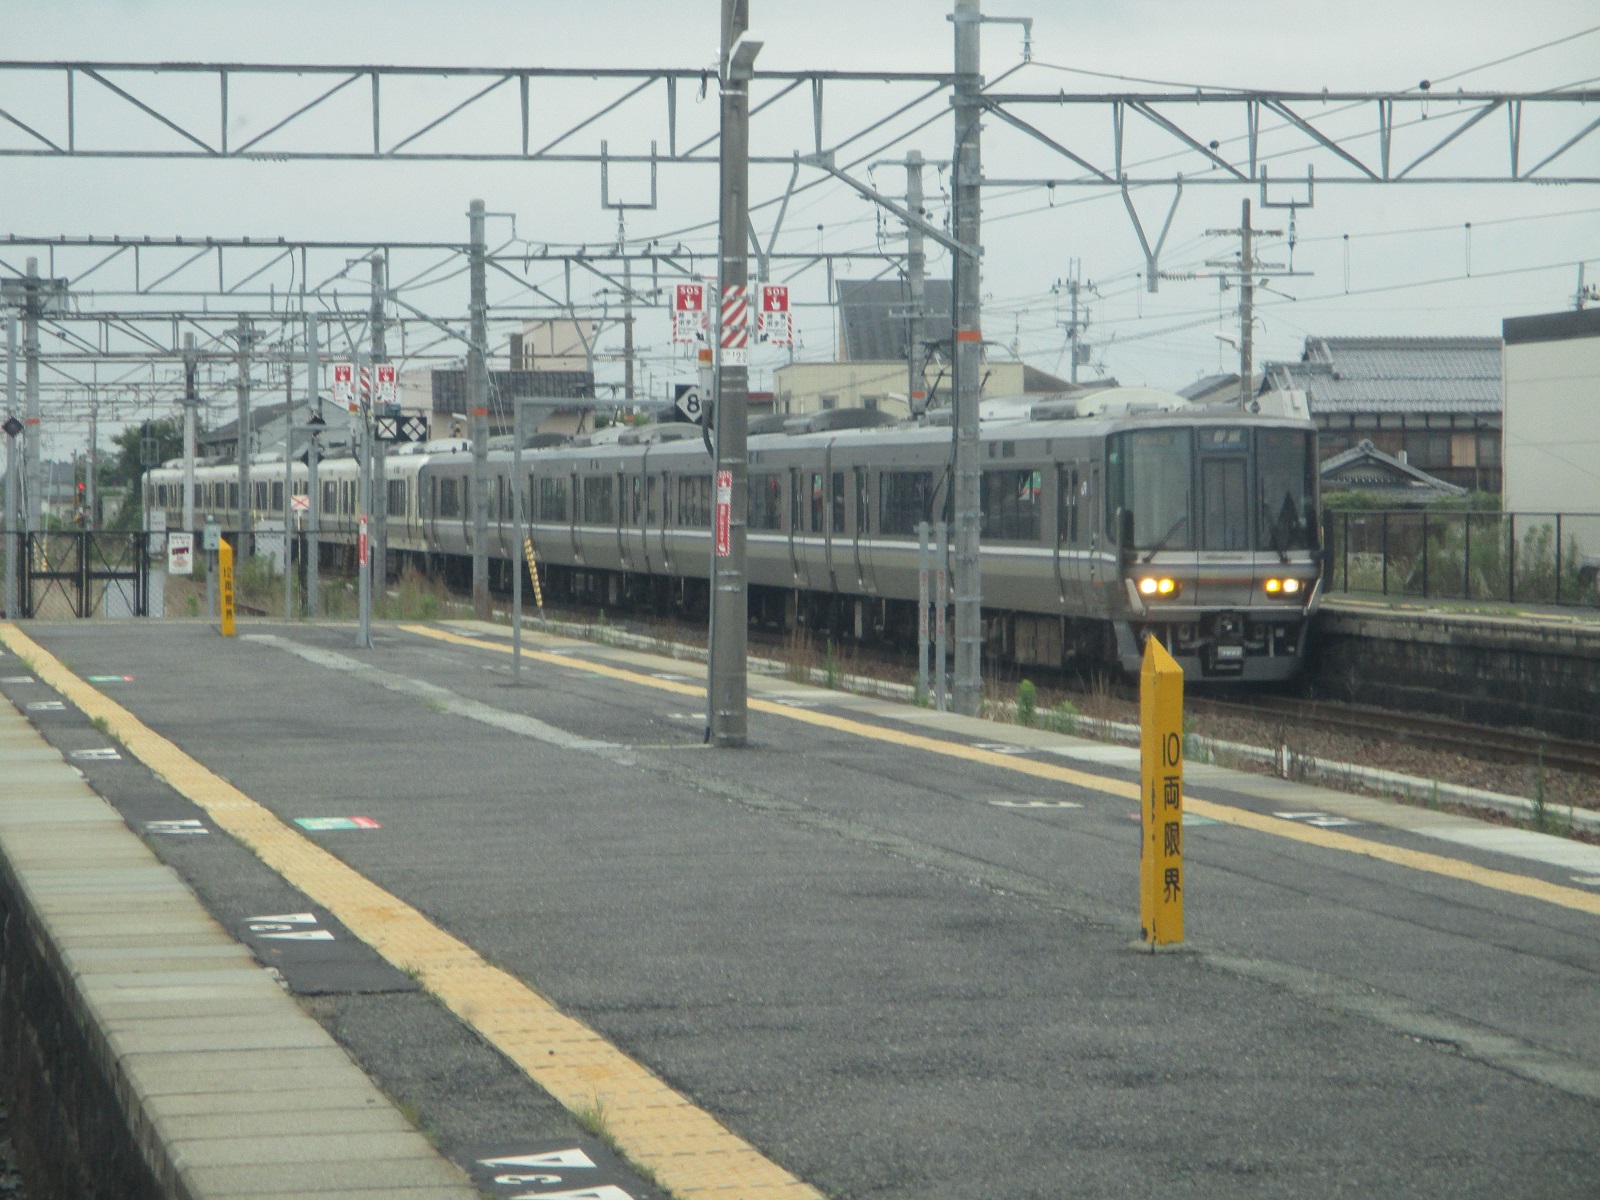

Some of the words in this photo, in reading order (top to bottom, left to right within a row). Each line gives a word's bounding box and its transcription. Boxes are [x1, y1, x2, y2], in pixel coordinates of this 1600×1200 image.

[680, 286, 699, 295] SOS
[767, 287, 785, 296] SOS
[687, 393, 700, 413] 8
[1162, 732, 1181, 904] 10両限界
